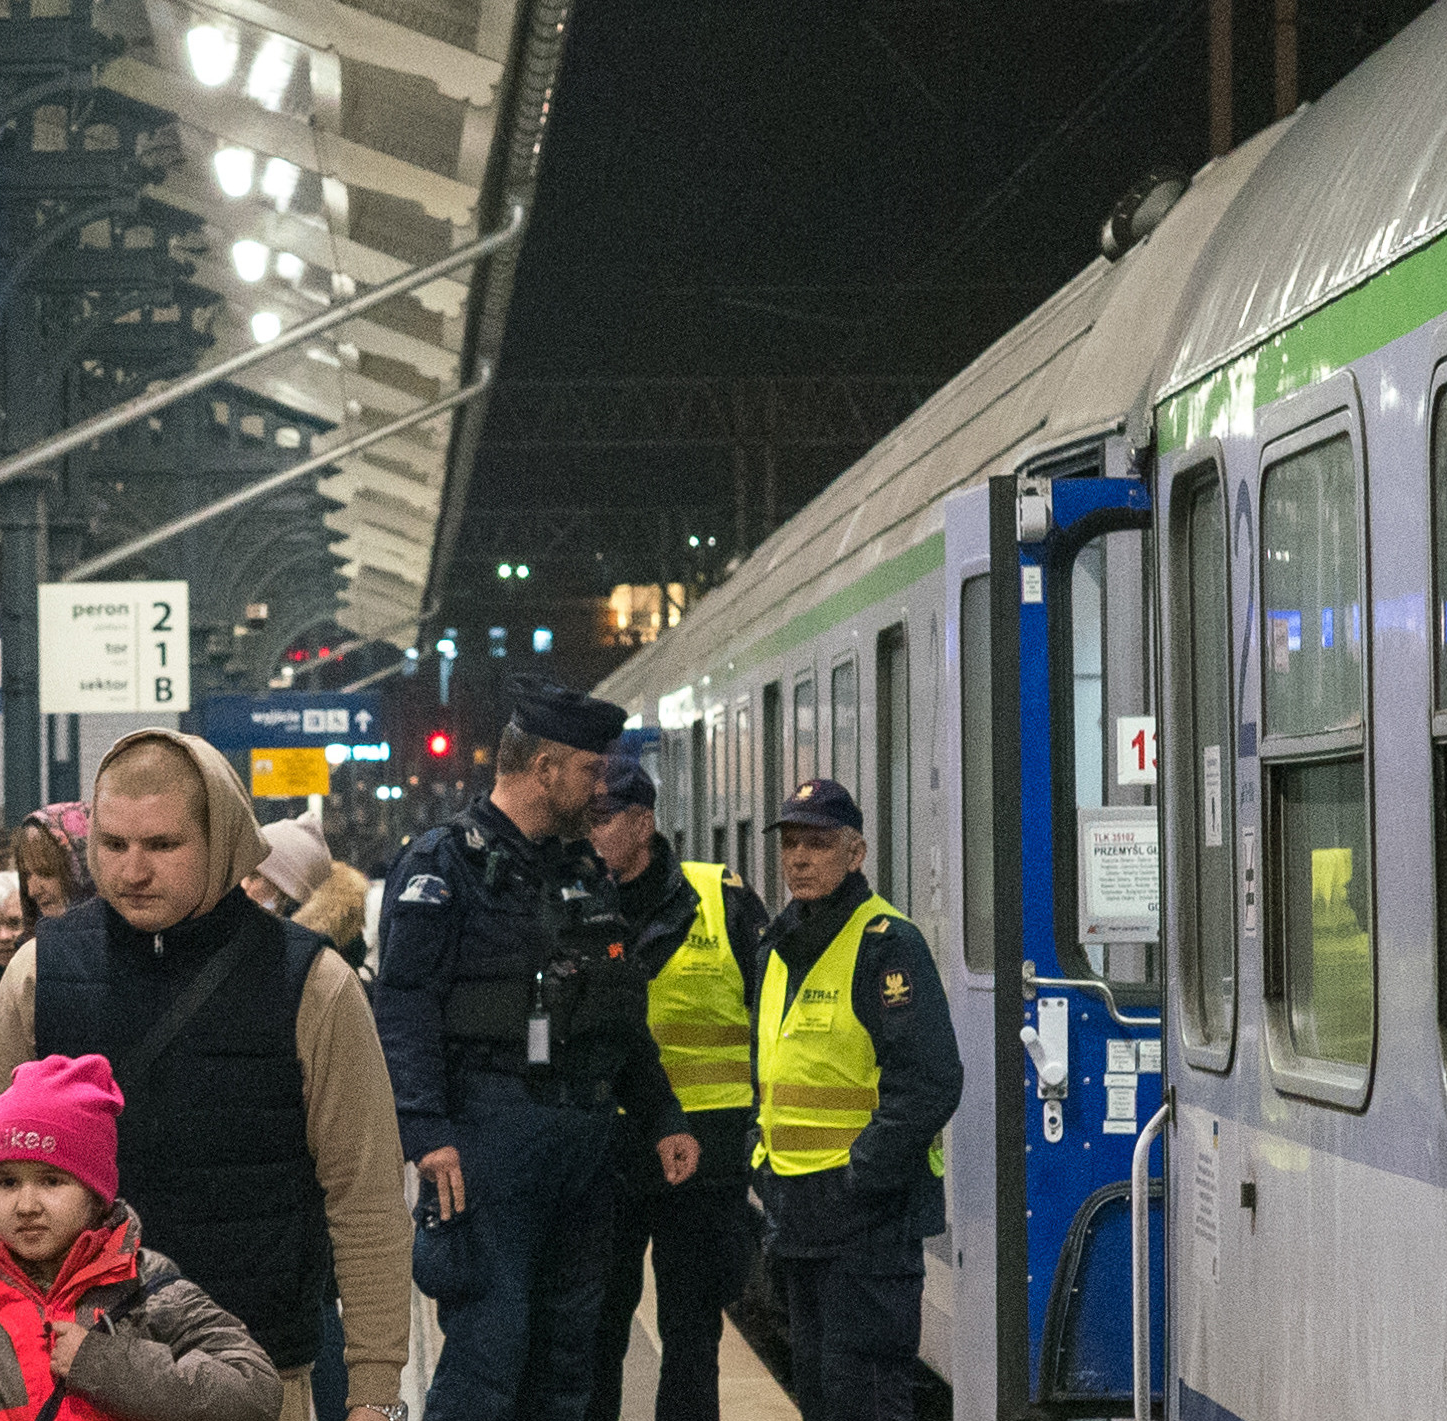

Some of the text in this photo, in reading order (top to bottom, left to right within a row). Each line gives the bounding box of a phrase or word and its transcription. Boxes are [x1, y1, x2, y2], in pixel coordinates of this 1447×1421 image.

[72, 601, 173, 631] peron 2
[155, 641, 167, 667] 1
[155, 677, 173, 702] B
[1131, 729, 1158, 770] 1
